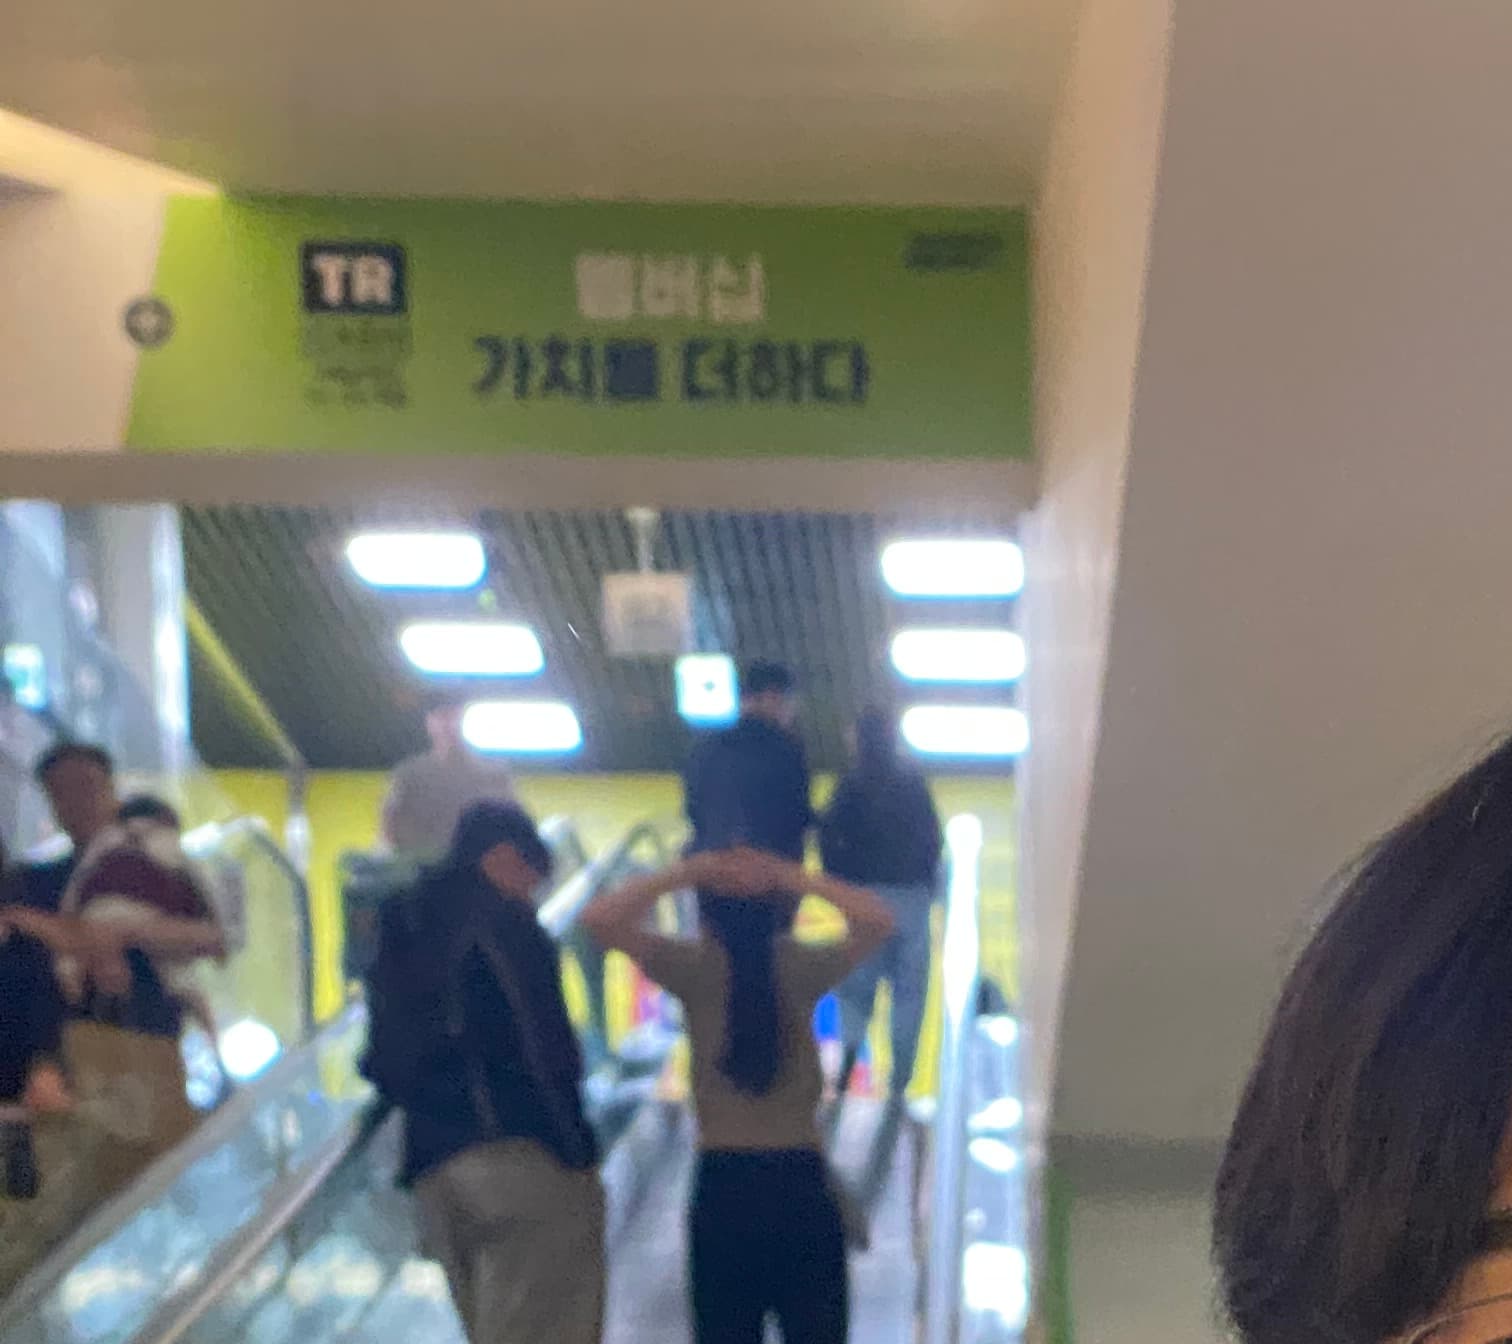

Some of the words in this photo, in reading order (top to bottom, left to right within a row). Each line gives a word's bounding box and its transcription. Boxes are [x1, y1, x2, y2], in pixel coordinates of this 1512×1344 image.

[311, 253, 394, 306] TR
[473, 334, 658, 403] 가치
[680, 336, 870, 404] 더하다
